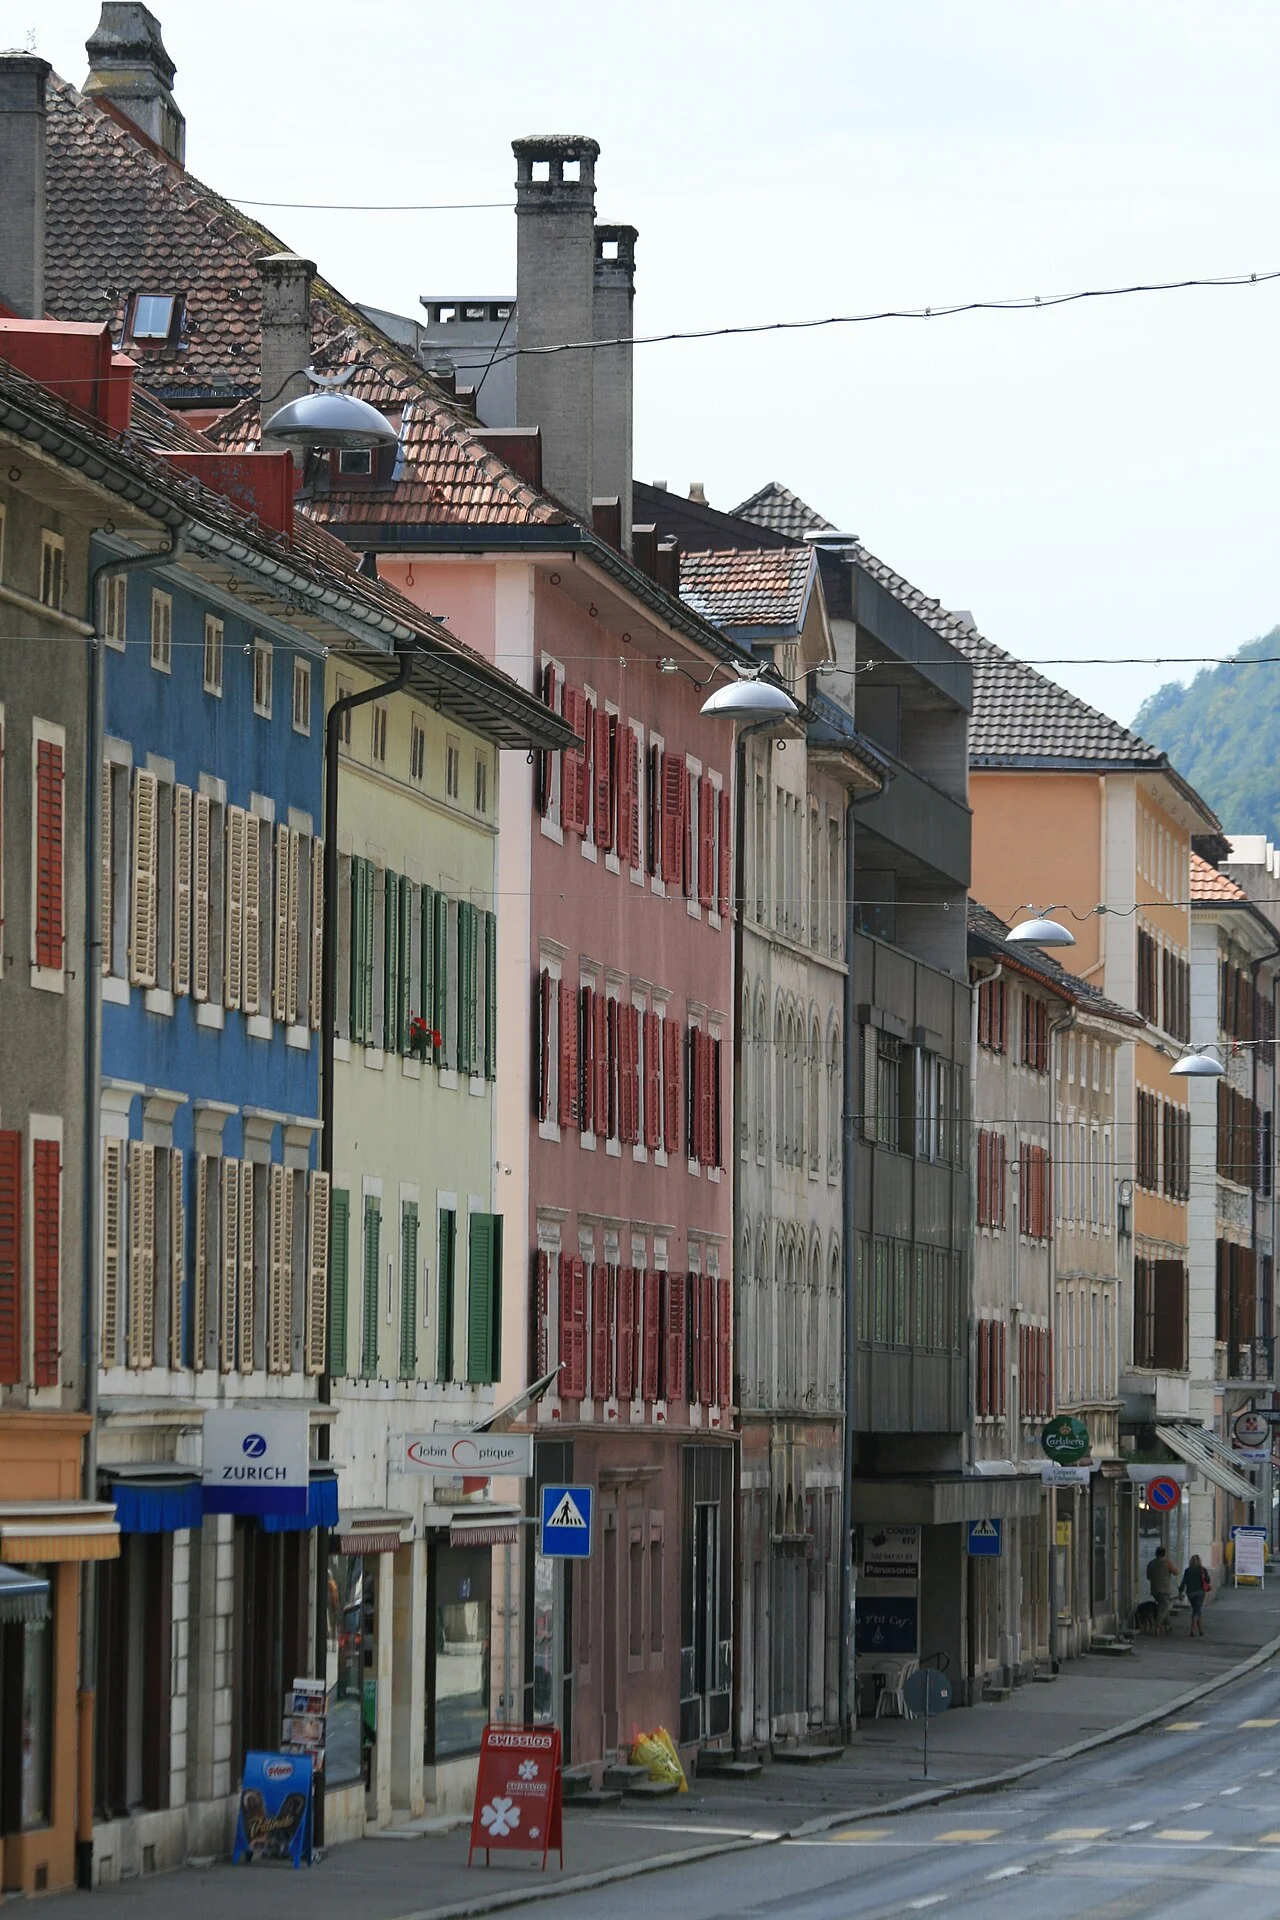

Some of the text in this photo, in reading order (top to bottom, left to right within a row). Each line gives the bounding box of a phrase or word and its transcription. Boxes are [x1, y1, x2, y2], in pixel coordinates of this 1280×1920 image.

[1046, 1434, 1085, 1448] Carlsberg
[419, 1445, 447, 1458] Jobin
[222, 1466, 287, 1480] ZURICH
[866, 1564, 917, 1575] Panasonic
[487, 1733, 552, 1748] SWISSLOS
